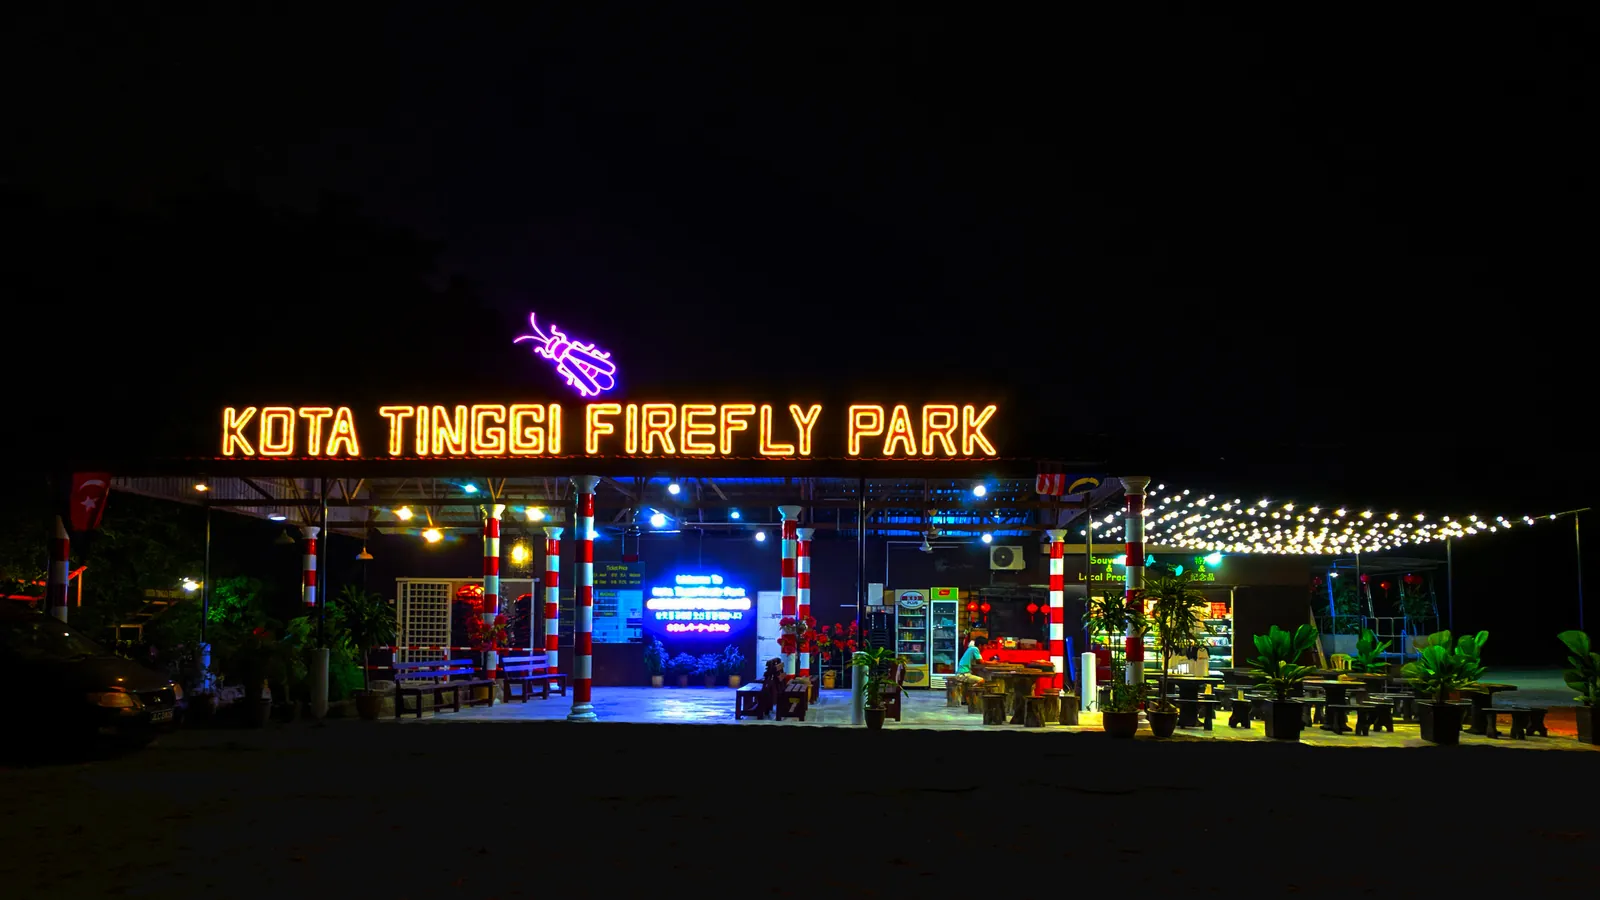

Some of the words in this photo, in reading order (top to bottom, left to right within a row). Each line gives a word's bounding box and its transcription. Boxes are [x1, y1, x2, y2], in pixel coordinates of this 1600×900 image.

[221, 406, 360, 456] KOTA
[378, 403, 562, 456] TINGGI
[585, 403, 823, 456] FIREFLY
[848, 404, 997, 457] PARK
[1106, 564, 1113, 573] &
[1198, 564, 1206, 572] &
